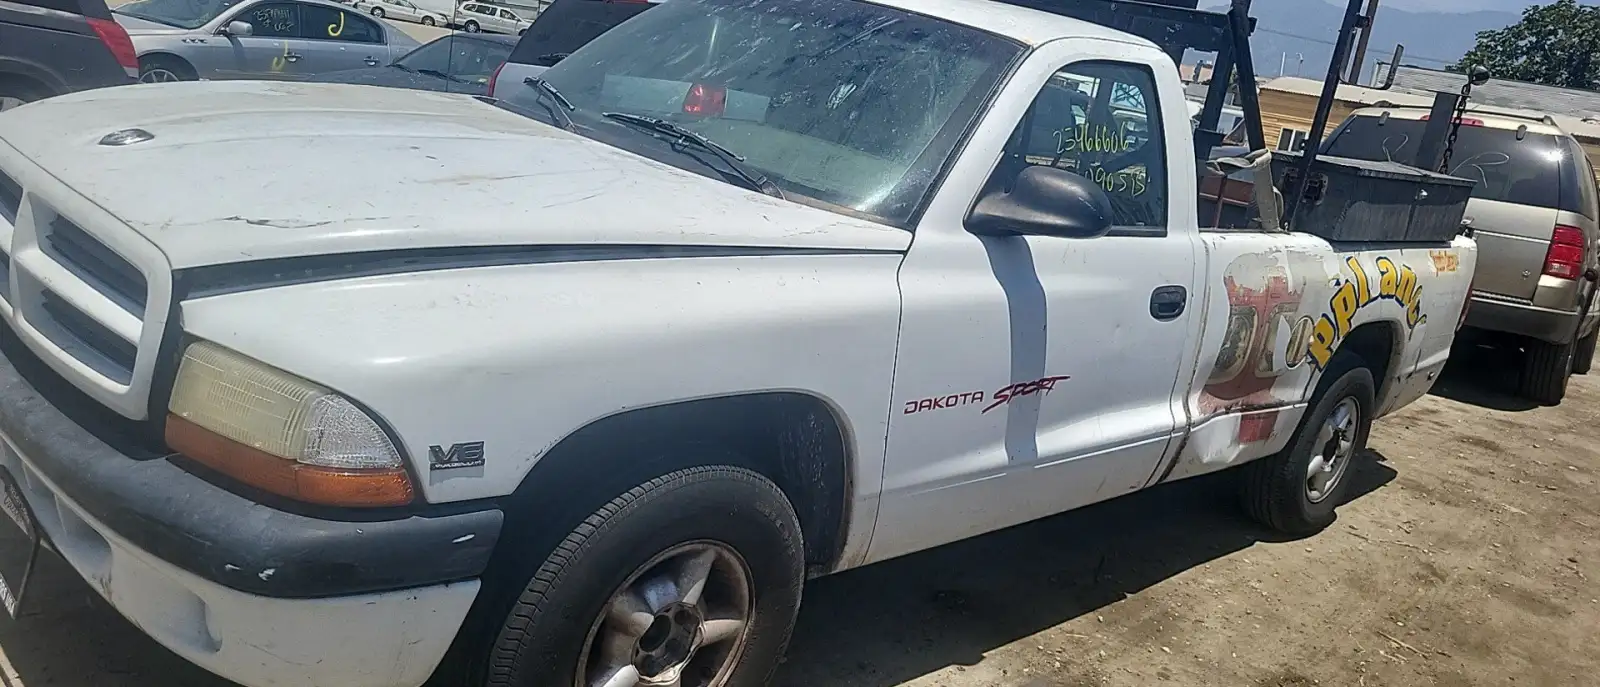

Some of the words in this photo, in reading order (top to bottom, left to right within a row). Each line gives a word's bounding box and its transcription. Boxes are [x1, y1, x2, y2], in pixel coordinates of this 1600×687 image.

[904, 391, 984, 414] DAKOTA
[982, 375, 1071, 414] SPORT
[429, 441, 485, 462] V6
